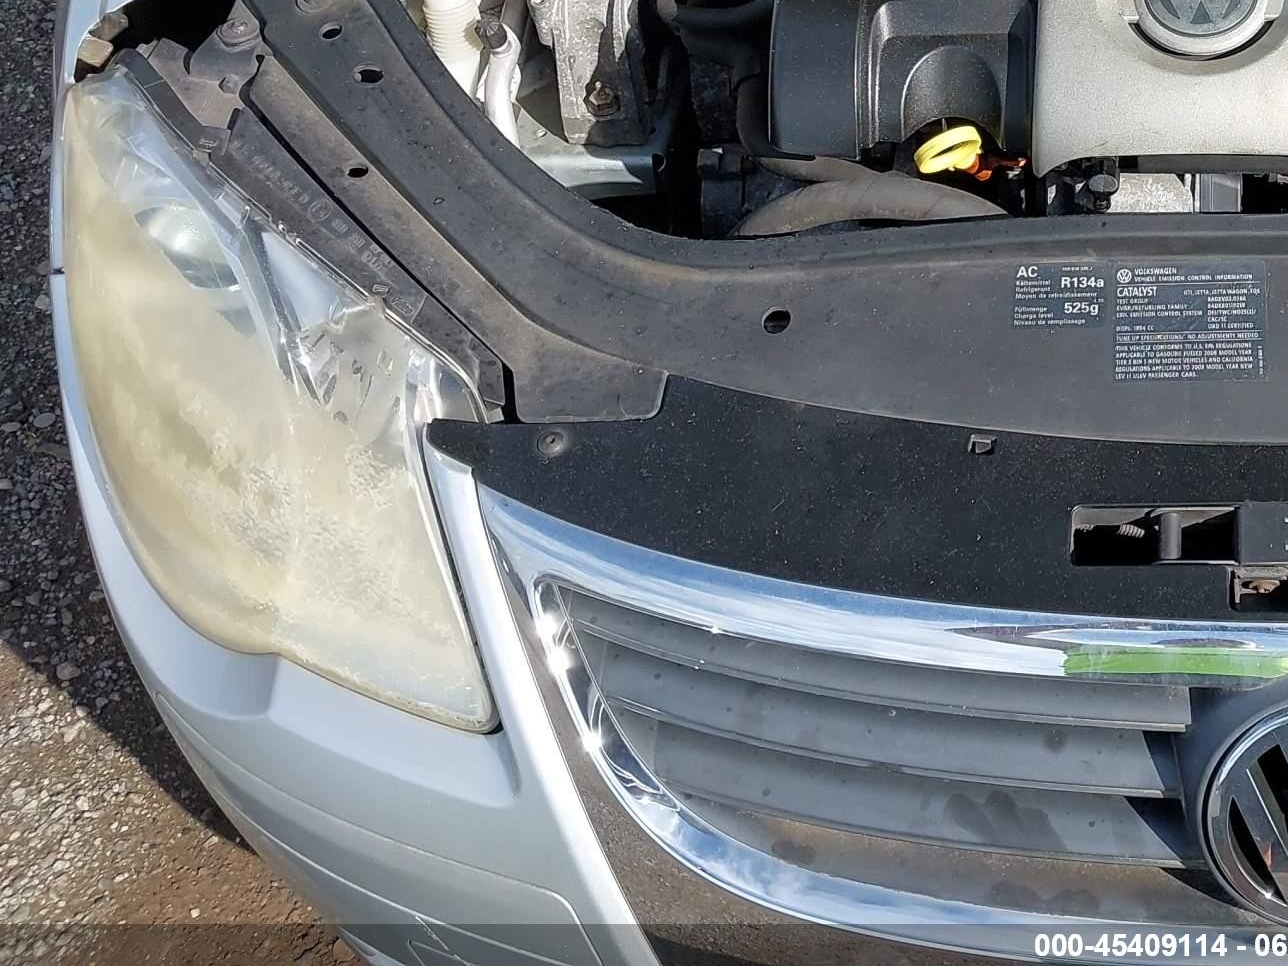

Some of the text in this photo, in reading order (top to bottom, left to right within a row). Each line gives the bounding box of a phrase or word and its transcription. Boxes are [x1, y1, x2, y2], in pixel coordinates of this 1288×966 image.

[1016, 266, 1038, 278] AC
[1134, 267, 1177, 275] VOLKSWAGEN
[1061, 276, 1104, 288] R134a
[1117, 286, 1158, 297] CATALYST
[1064, 302, 1098, 315] 525g
